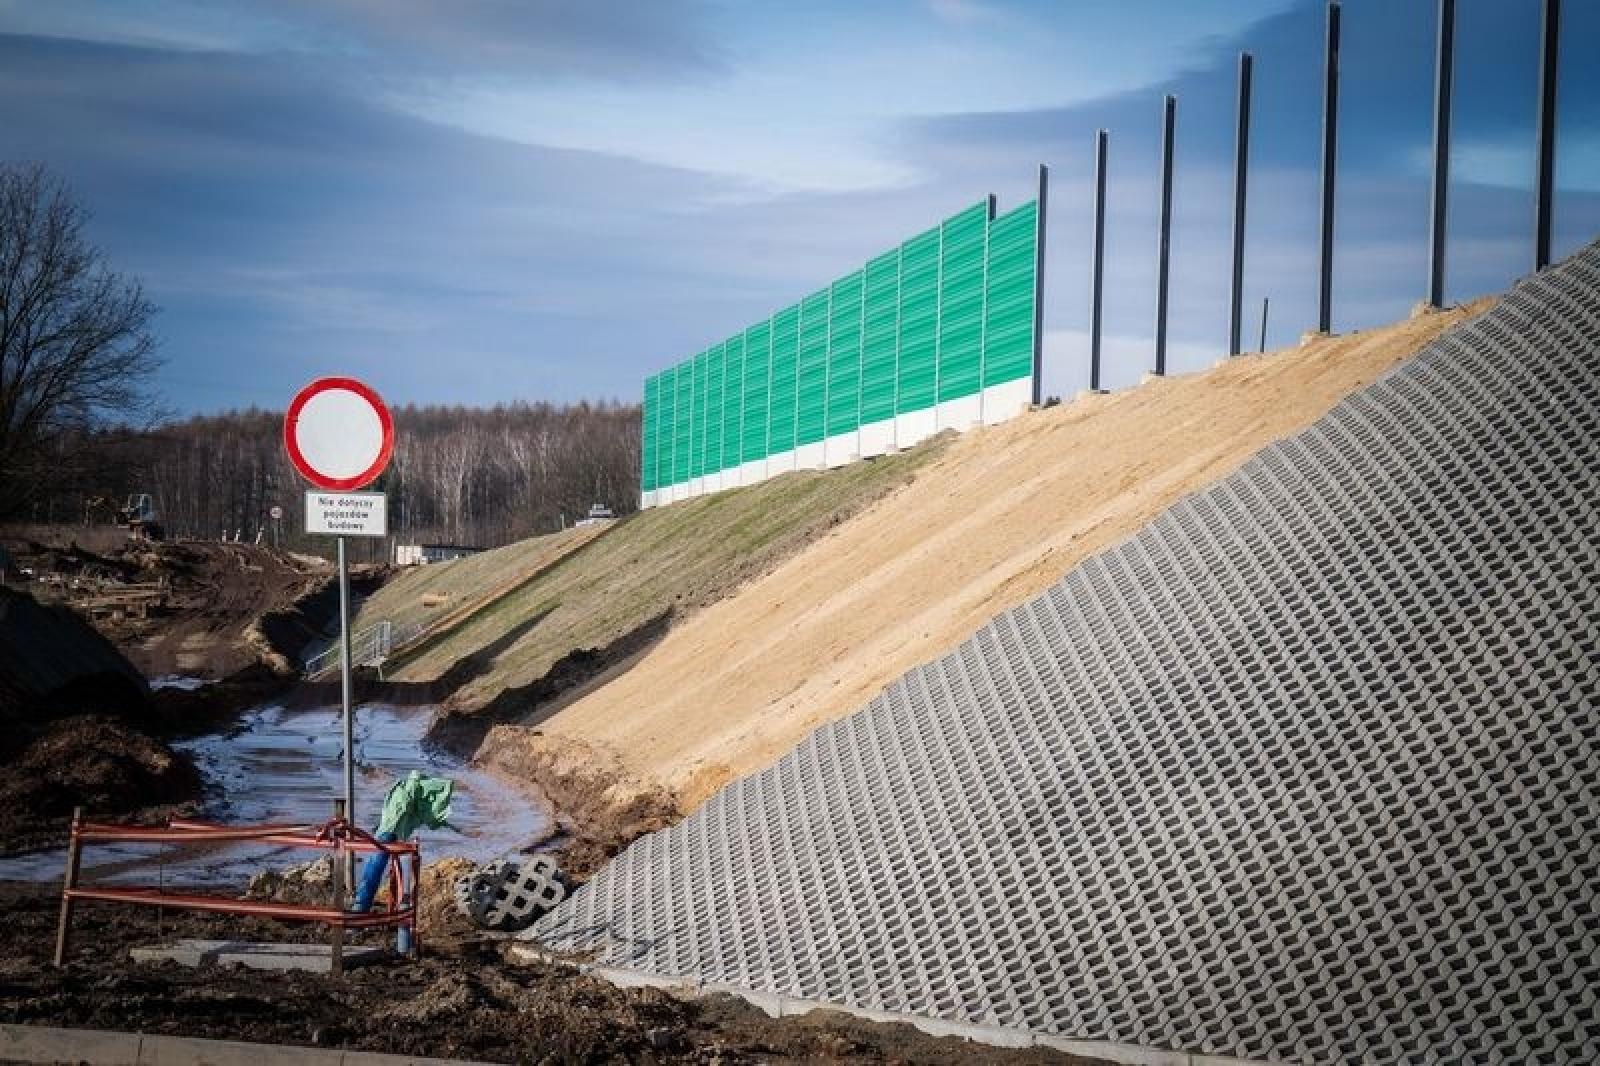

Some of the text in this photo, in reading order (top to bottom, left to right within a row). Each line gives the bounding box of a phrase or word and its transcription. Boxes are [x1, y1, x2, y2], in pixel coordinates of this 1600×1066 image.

[318, 497, 374, 509] Nie dotyczy
[328, 521, 364, 532] budowy
